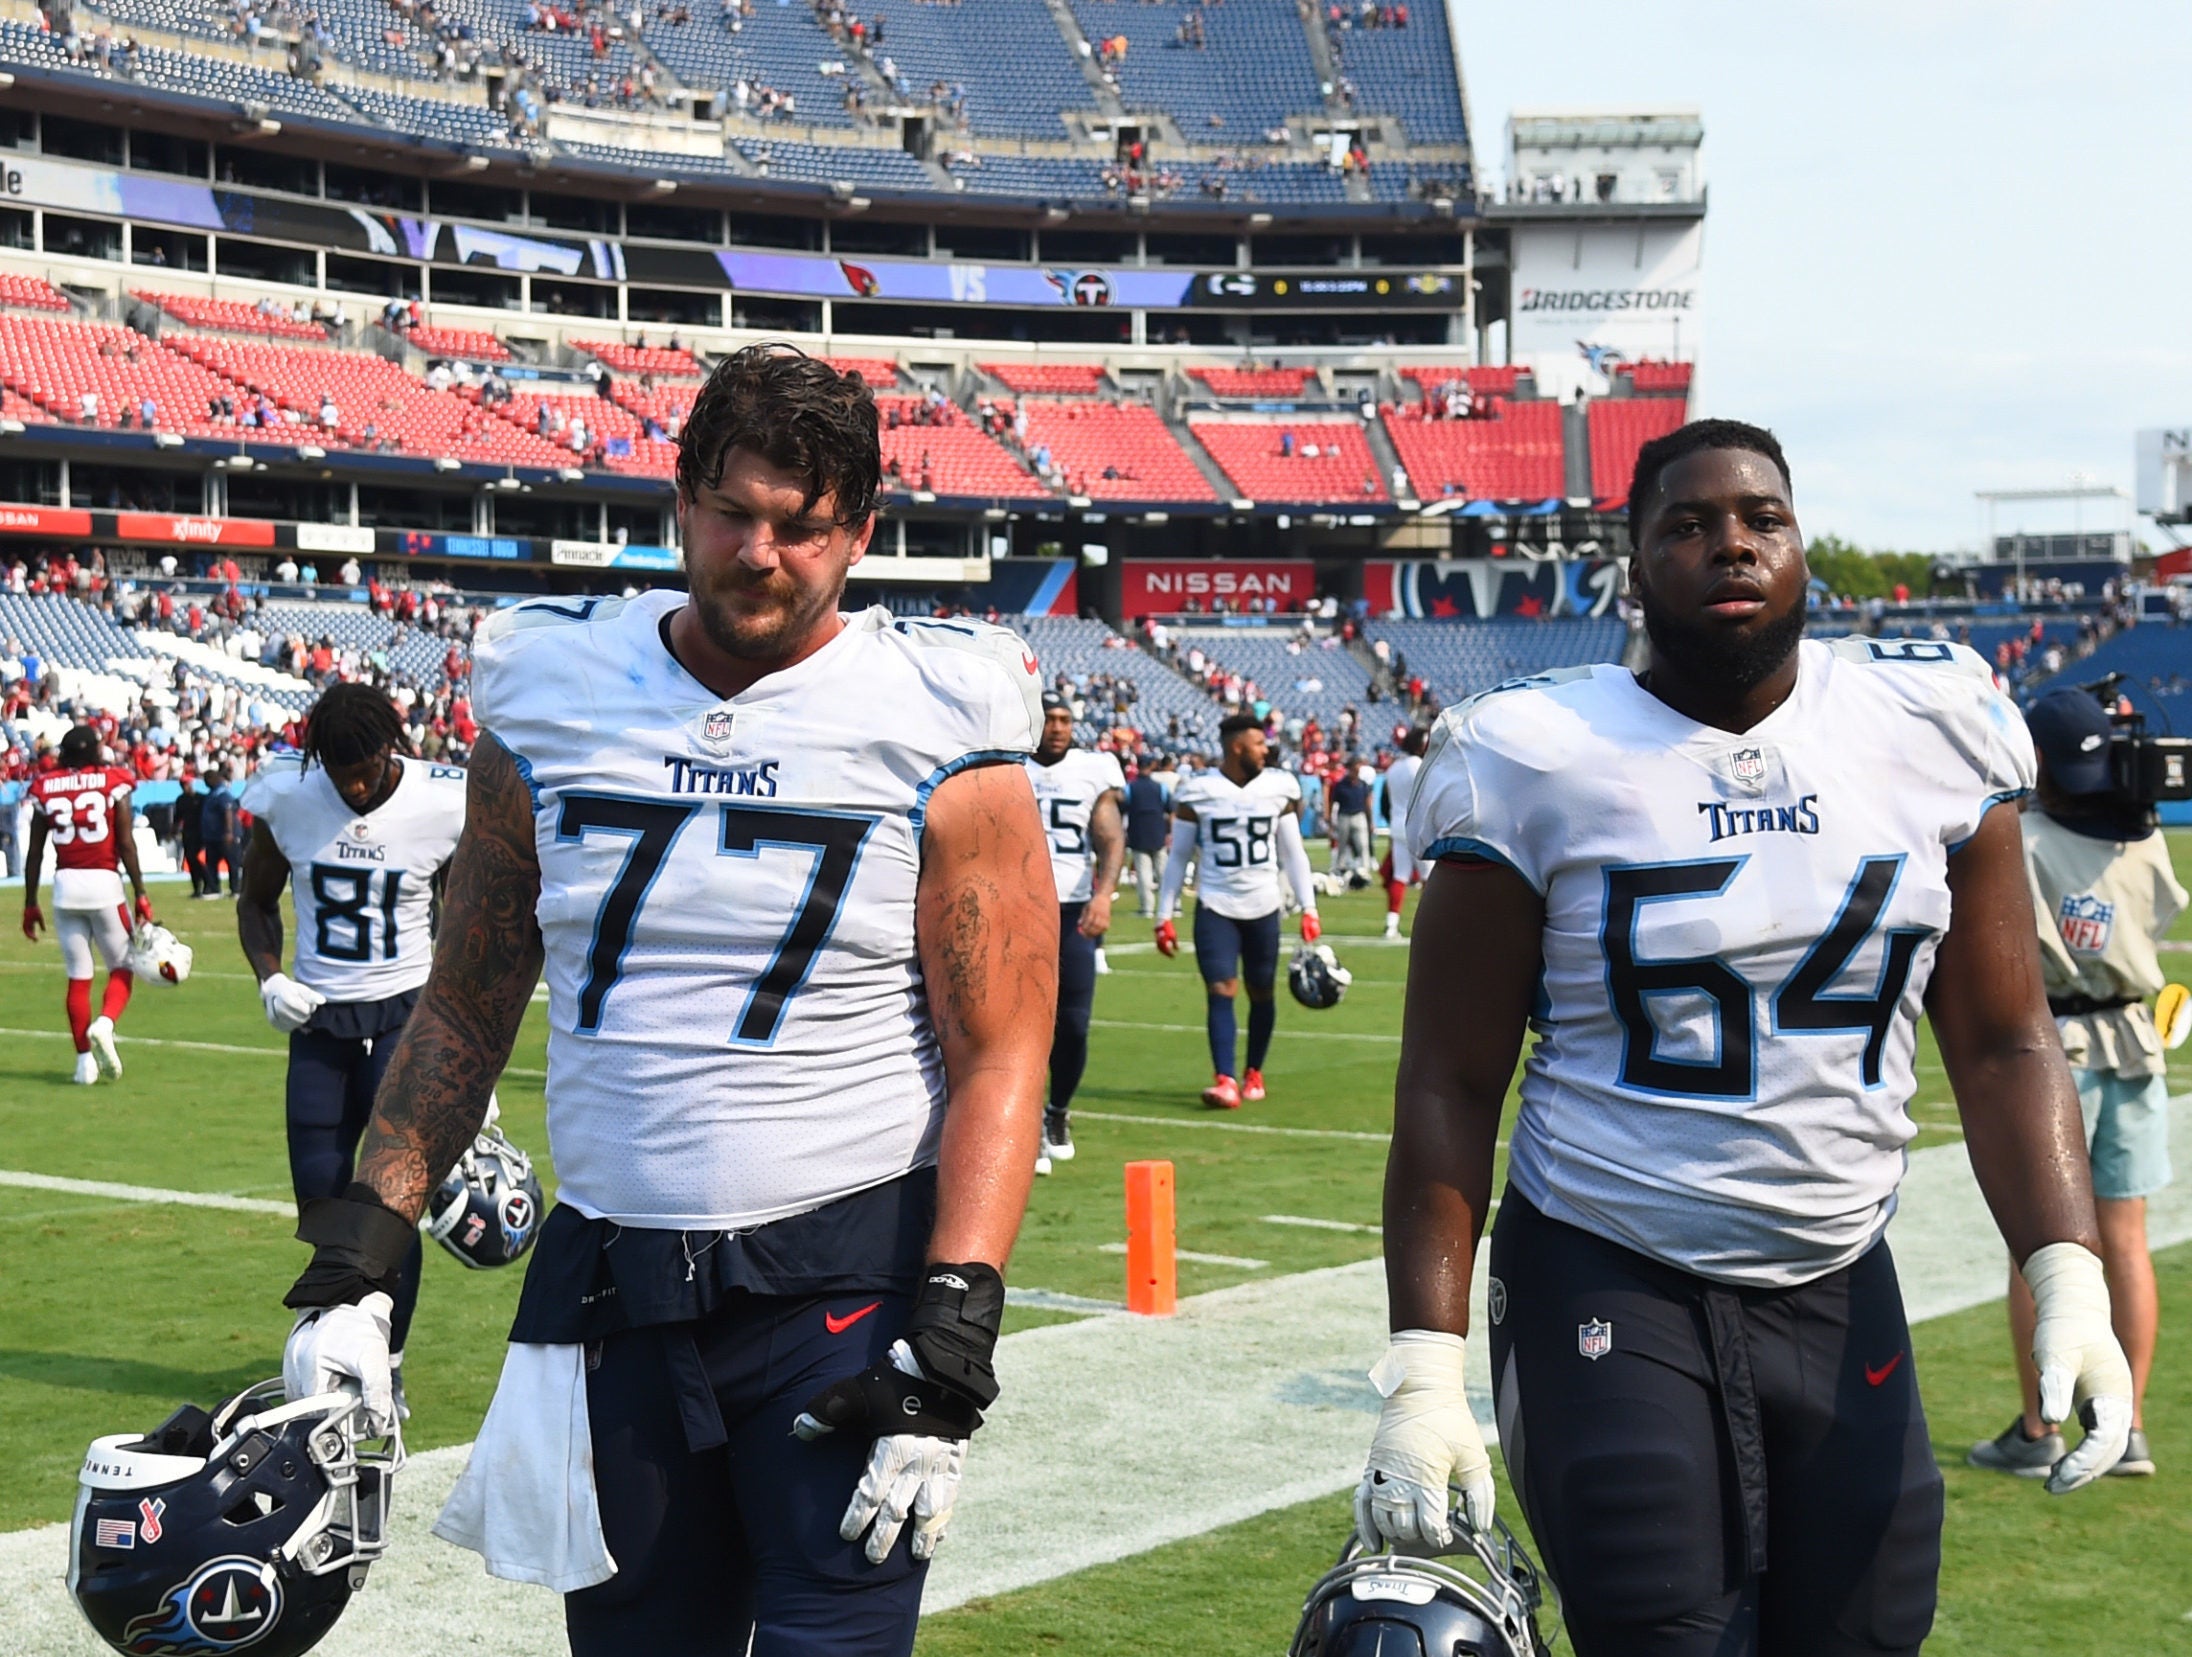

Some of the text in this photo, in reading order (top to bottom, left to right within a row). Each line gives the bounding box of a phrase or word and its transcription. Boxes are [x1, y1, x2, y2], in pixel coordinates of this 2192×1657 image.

[949, 265, 987, 302] VS
[1520, 289, 1696, 311] BRIDGESTONE
[172, 517, 222, 543] xfinity
[1146, 572, 1291, 594] NISSAN
[707, 723, 729, 737] NFL
[43, 772, 107, 794] HAMILTON
[664, 756, 779, 797] TITANS
[1738, 759, 1761, 776] NFL
[45, 790, 109, 845] 33
[1697, 794, 1820, 843] TITANS
[1210, 815, 1273, 868] 58
[310, 860, 408, 963] 81
[555, 790, 885, 1048] 77
[2063, 916, 2104, 950] NFL
[1600, 852, 1943, 1102] 64
[1584, 1335, 1607, 1354] NFL
